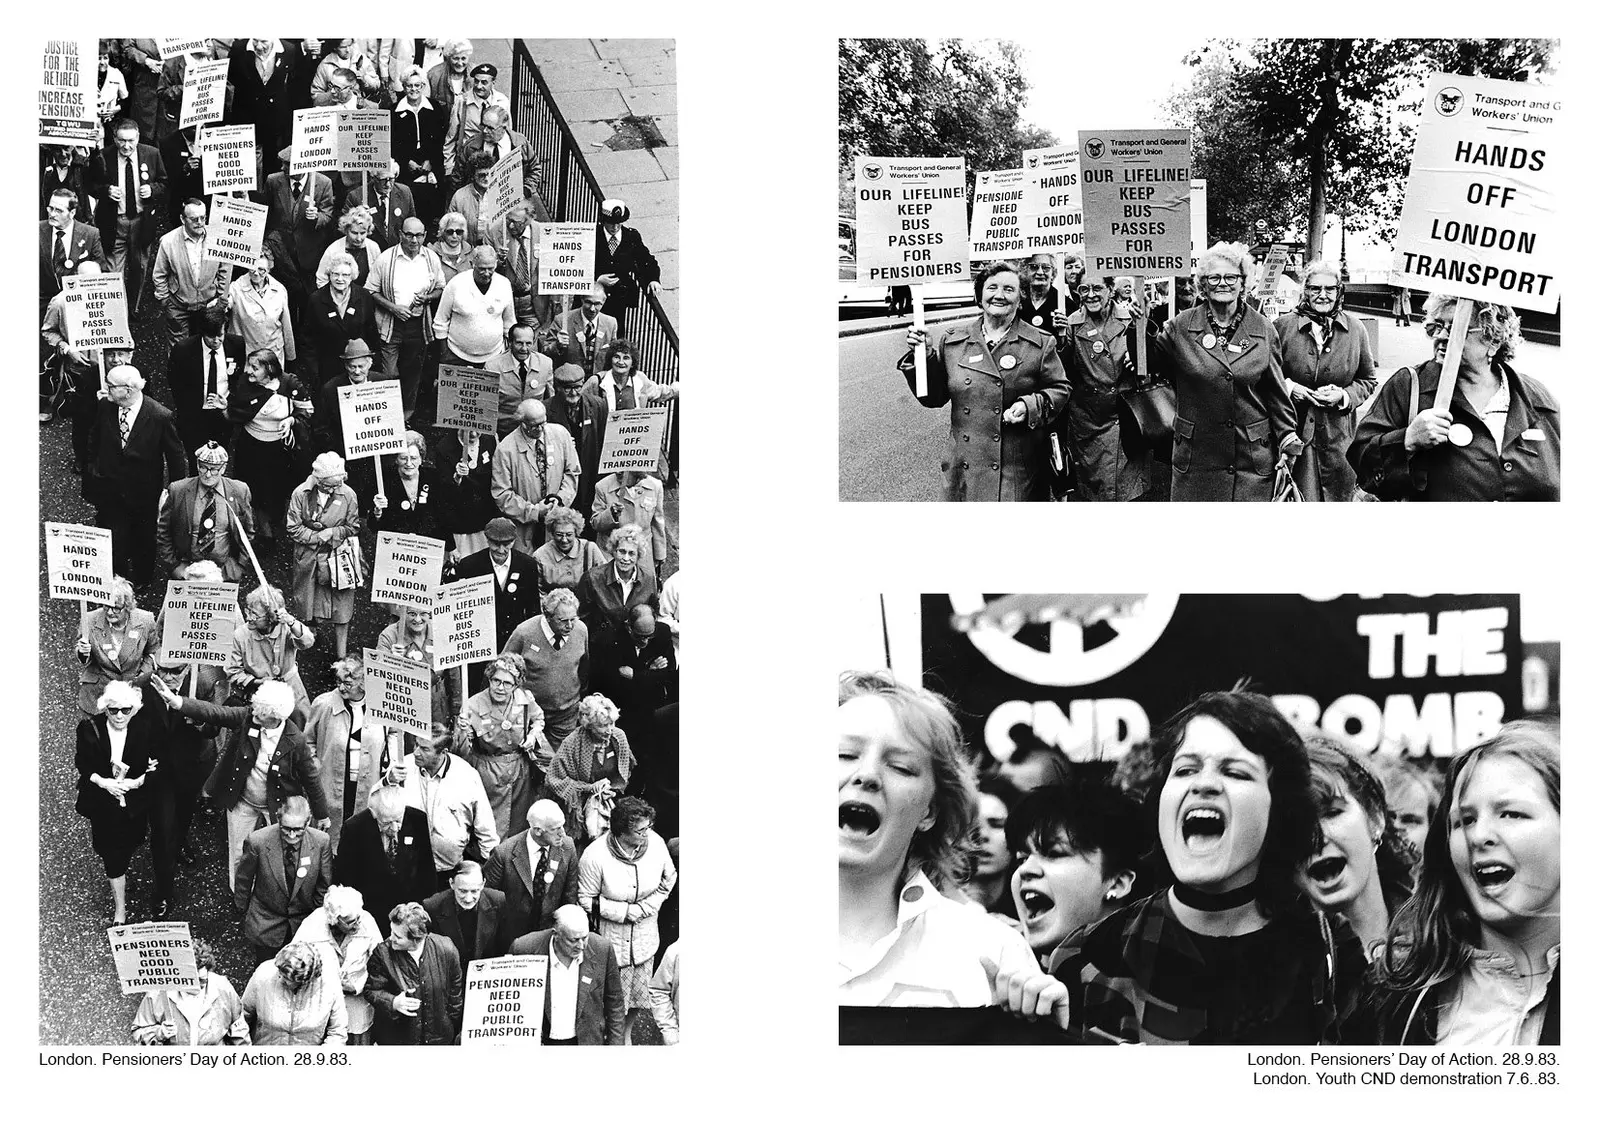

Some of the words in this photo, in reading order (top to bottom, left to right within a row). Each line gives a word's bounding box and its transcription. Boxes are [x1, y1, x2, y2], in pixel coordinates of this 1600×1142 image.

[45, 40, 78, 55] JUSTICE
[44, 55, 59, 70] FOR
[65, 56, 79, 72] THE
[44, 71, 79, 87] RETIRED
[1475, 93, 1526, 108] Transport
[1529, 100, 1550, 109] and
[1472, 107, 1520, 120] Workers'
[1523, 113, 1553, 124] Union
[304, 124, 330, 134] HANDS
[204, 140, 253, 152] PENSIONERS
[309, 136, 323, 144] OFF
[1110, 139, 1144, 147] Transport
[218, 151, 239, 159] NEED
[300, 148, 332, 158] LONDON
[1455, 141, 1546, 172] HANDS
[218, 160, 240, 168] GOOD
[293, 158, 337, 170] TRANSPORT
[216, 169, 244, 178] PUBLIC
[1084, 170, 1113, 183] OUR
[1125, 168, 1189, 182] LIFELINE!
[207, 177, 253, 188] TRANSPORT
[1041, 174, 1077, 189] HANDS
[860, 189, 892, 200] OUR
[903, 187, 964, 200] LIFELINE!
[976, 190, 1023, 203] PENSIONE
[1120, 187, 1155, 200] KEEP
[1467, 183, 1517, 208] OFF
[1049, 195, 1069, 207] OFF
[898, 203, 932, 215] KEEP
[992, 203, 1017, 214] NEED
[1124, 205, 1152, 218] BUS
[223, 215, 252, 227] HANDS
[902, 218, 930, 230] BUS
[990, 216, 1017, 226] GOOD
[1037, 214, 1082, 228] LONDON
[227, 228, 244, 237] OFF
[986, 228, 1020, 239] PUBLIC
[1111, 222, 1166, 235] PASSES
[889, 233, 943, 246] PASSES
[1431, 218, 1536, 254] LONDON
[216, 238, 251, 252] LONDON
[553, 242, 582, 250] HANDS
[1126, 240, 1152, 252] FOR
[208, 249, 256, 265] TRANSPORT
[904, 249, 931, 262] FOR
[1096, 256, 1183, 270] PENSIONERS
[549, 269, 584, 277] LONDON
[871, 262, 962, 280] PENSIONERS
[1403, 252, 1553, 296] TRANSPORT
[542, 282, 591, 290] TRANSPORT
[66, 294, 82, 302] OUR
[88, 292, 123, 300] LIFELINE!
[86, 301, 105, 309] KEEP
[82, 319, 113, 328] PASSES
[91, 328, 106, 336] FOR
[75, 337, 124, 347] PENSIONERS
[440, 380, 457, 388] OUR
[459, 390, 479, 398] KEEP
[355, 402, 387, 413] HANDS
[461, 398, 477, 406] BUS
[453, 404, 484, 414] PASSES
[364, 416, 382, 425] OFF
[443, 418, 492, 431] PENSIONERS
[356, 428, 394, 440] LONDON
[619, 426, 650, 434] HANDS
[349, 440, 403, 454] TRANSPORT
[624, 437, 640, 445] OFF
[612, 449, 649, 457] LONDON
[603, 460, 655, 469] TRANSPORT
[63, 545, 97, 556] HANDS
[72, 560, 91, 569] OFF
[392, 553, 427, 565] HANDS
[398, 566, 417, 576] OFF
[62, 573, 102, 585] LONDON
[386, 578, 427, 592] LONDON
[54, 585, 111, 600] TRANSPORT
[376, 590, 433, 606] TRANSPORT
[168, 601, 187, 609] OUR
[194, 602, 236, 612] LIFELINE!
[434, 605, 451, 615] OUR
[456, 596, 493, 610] LIFELINE!
[190, 612, 212, 620] KEEP
[453, 610, 474, 621] KEEP
[191, 622, 209, 630] BUS
[456, 620, 472, 631] BUS
[182, 631, 217, 640] PASSES
[449, 629, 480, 643] PASSES
[190, 642, 207, 650] FOR
[457, 641, 473, 651] FOR
[1357, 607, 1508, 680] THE
[168, 651, 226, 662] PENSIONERS
[440, 648, 492, 665] PENSIONERS
[367, 667, 429, 690] PENSIONERS
[386, 682, 411, 695] NEED
[385, 692, 413, 706] GOOD
[382, 701, 417, 717] PUBLIC
[370, 708, 428, 730] TRANSPORT
[1274, 690, 1506, 757] BOMB
[984, 696, 1150, 763] CND
[115, 940, 190, 952] PENSIONERS
[139, 950, 170, 958] NEED
[140, 959, 174, 967] GOOD
[138, 968, 180, 976] PUBLIC
[126, 978, 194, 987] TRANSPORT
[470, 978, 544, 990] PENSIONERS
[490, 990, 520, 1000] NEED
[488, 1002, 521, 1013] GOOD
[482, 1015, 524, 1025] PUBLIC
[468, 1027, 537, 1038] TRANSPORT
